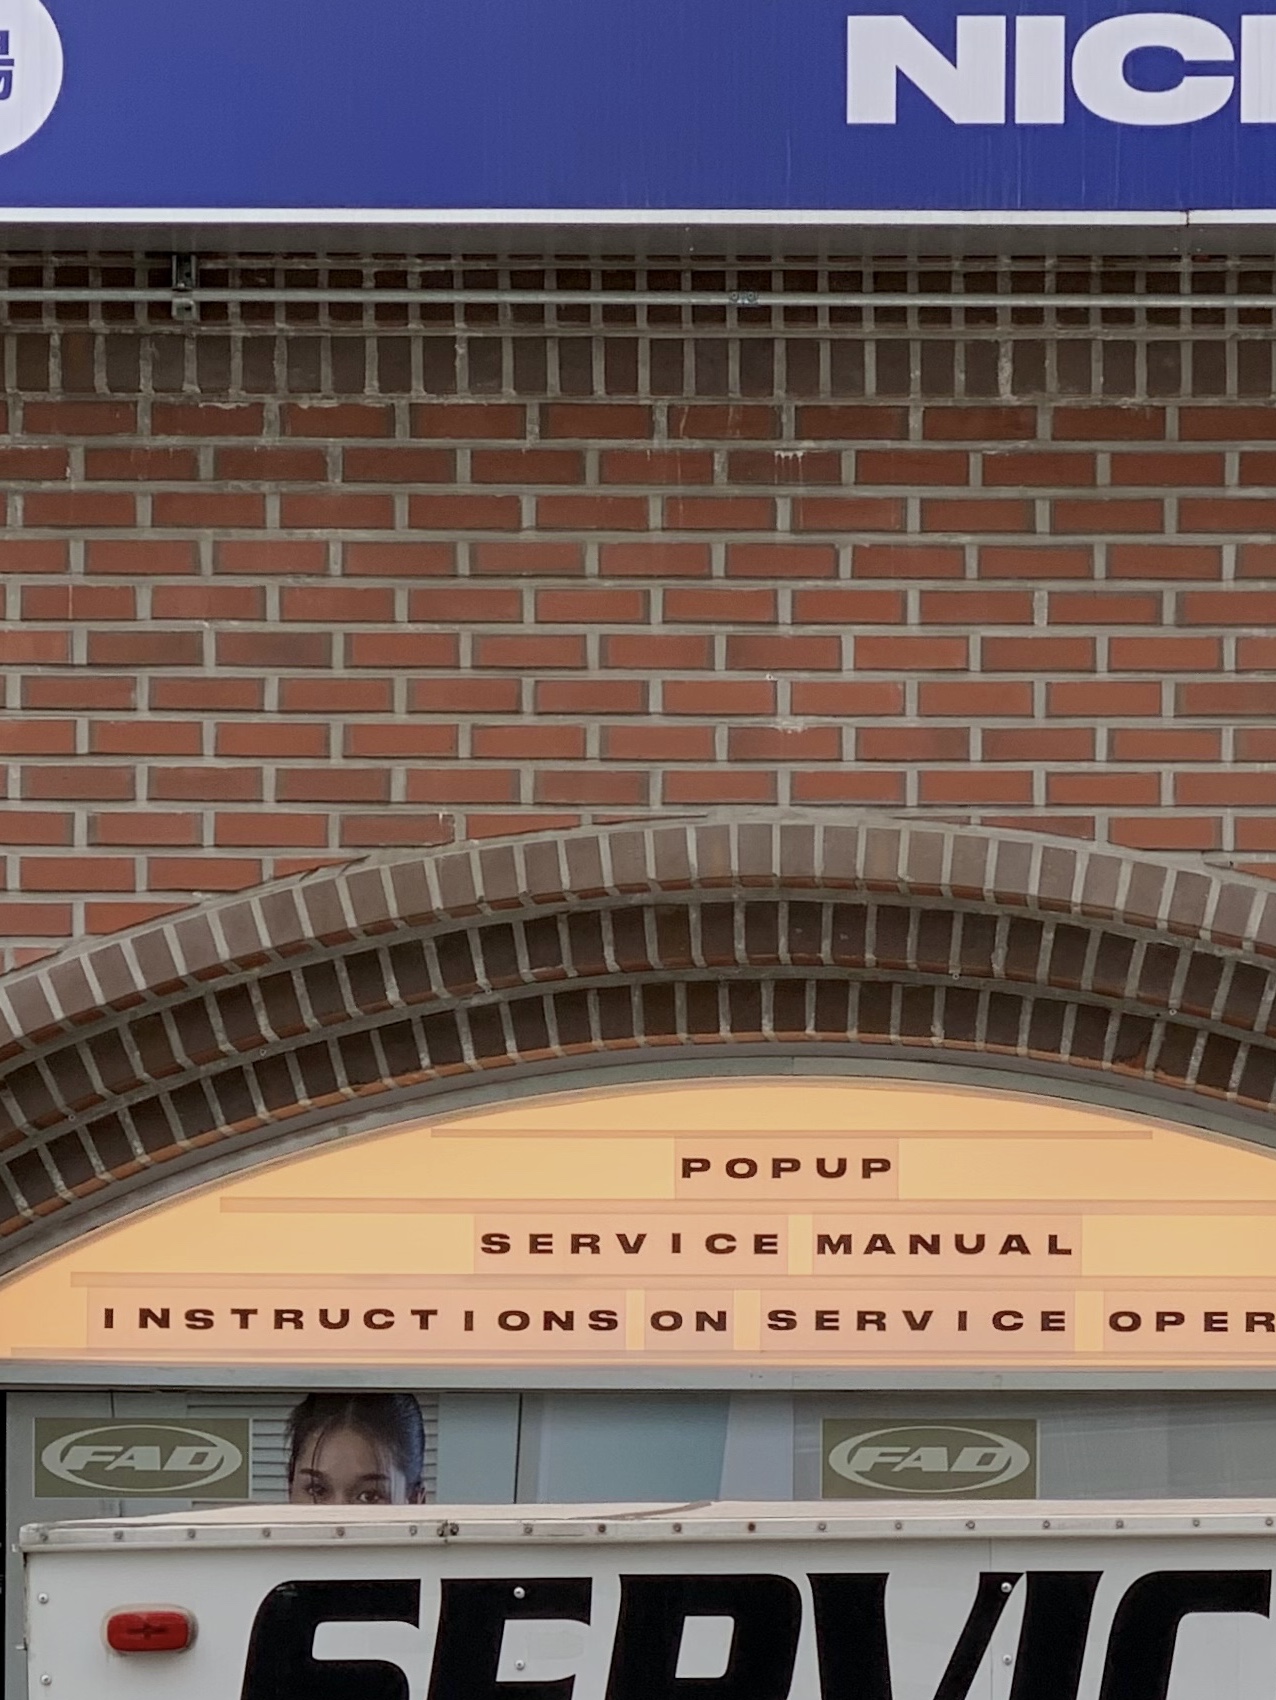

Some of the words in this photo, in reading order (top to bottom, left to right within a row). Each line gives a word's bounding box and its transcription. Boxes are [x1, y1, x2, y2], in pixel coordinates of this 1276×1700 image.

[681, 1157, 891, 1180] POPUP
[480, 1232, 779, 1256] SERVICE
[816, 1233, 1072, 1256] MANUAL
[104, 1307, 619, 1332] INSTRUCTIONS
[650, 1309, 728, 1333] ON
[767, 1309, 1067, 1333] SERVICE
[60, 1446, 223, 1471] FAD
[849, 1447, 1012, 1471] FAD
